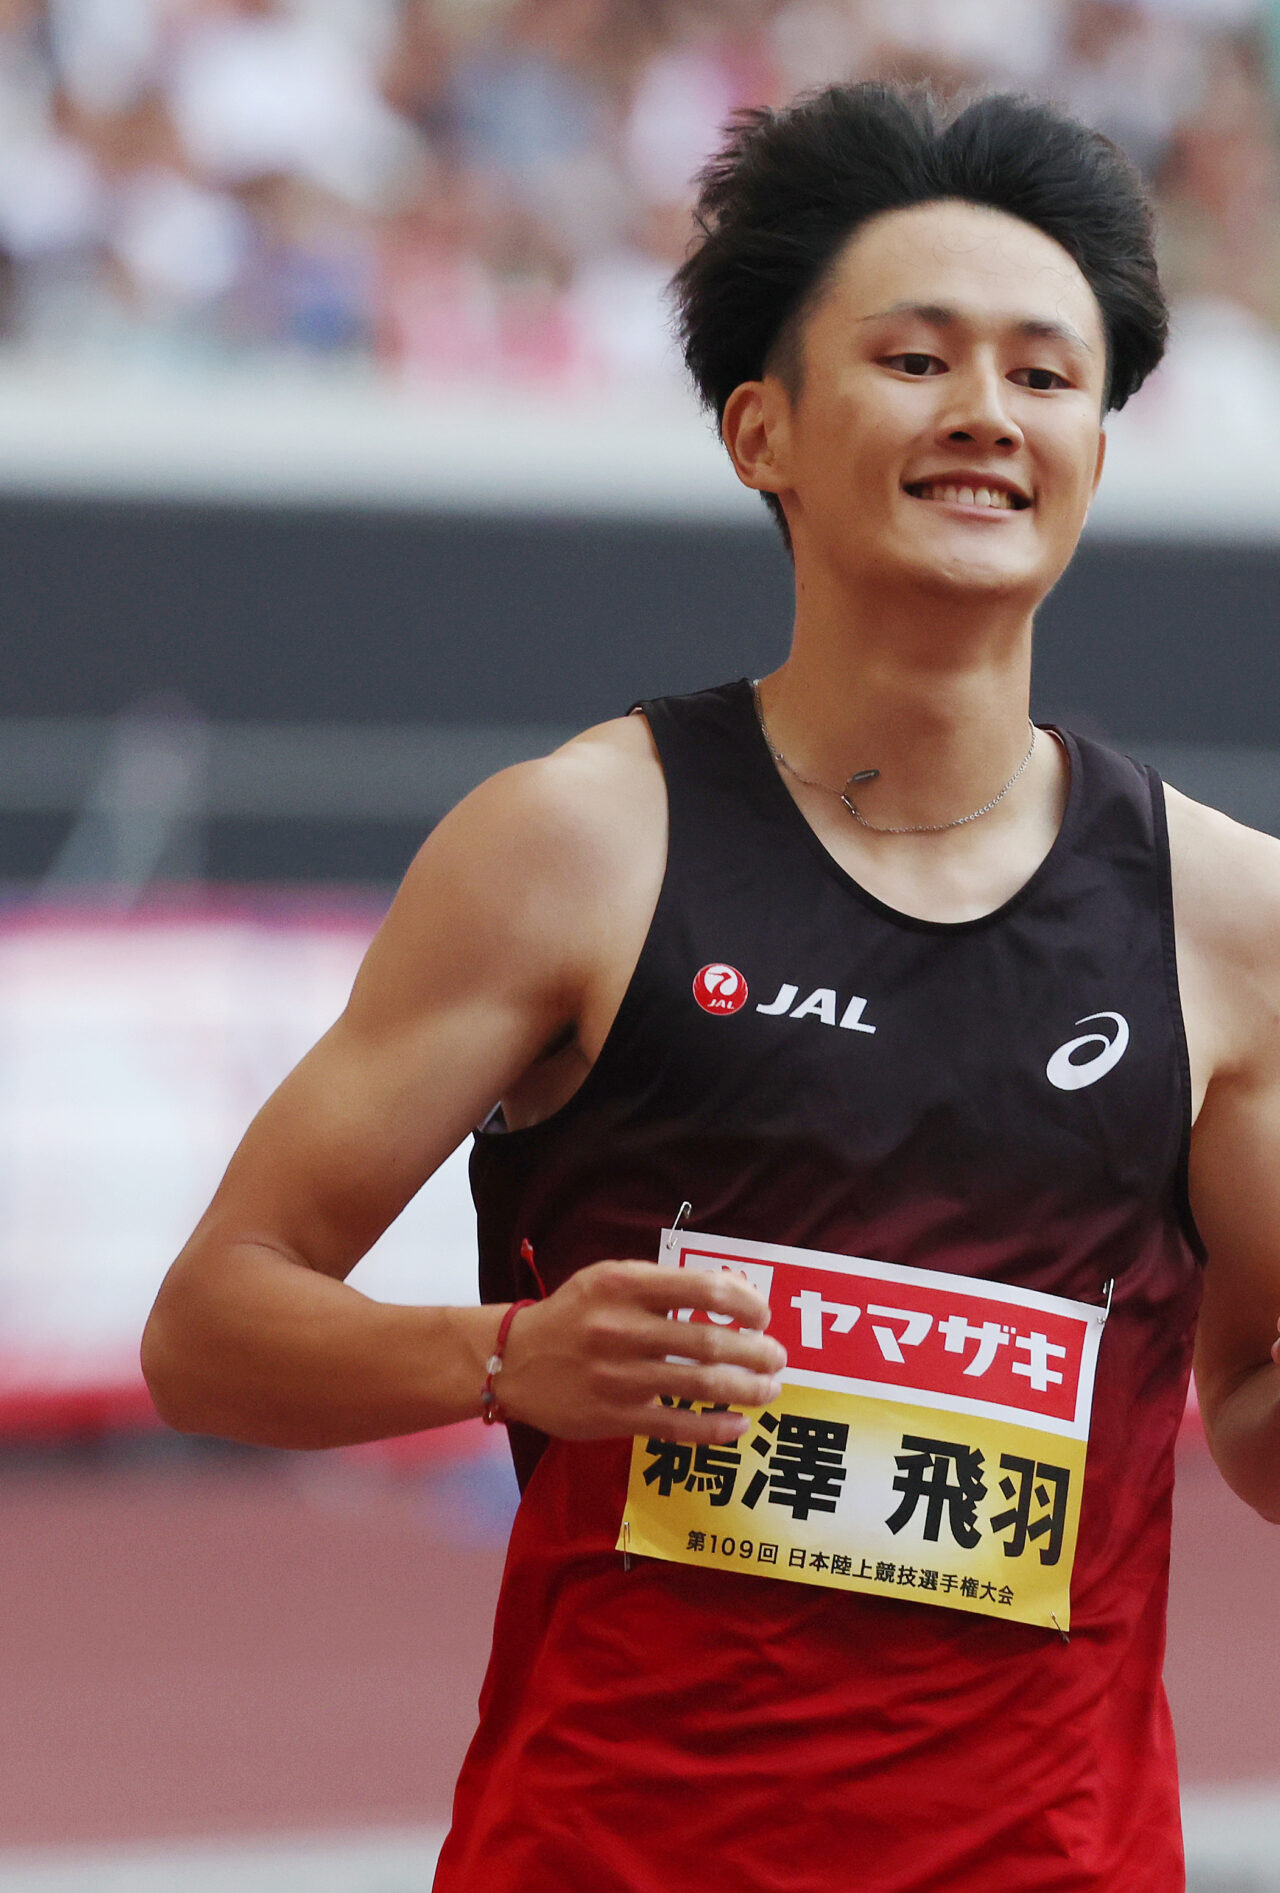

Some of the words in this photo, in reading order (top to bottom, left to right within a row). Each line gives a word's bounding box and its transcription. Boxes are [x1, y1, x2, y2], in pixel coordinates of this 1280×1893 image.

[707, 997, 735, 1010] JAL
[756, 983, 876, 1034] JAL
[790, 1289, 1067, 1393] ヤマザキ
[885, 1433, 1071, 1567] 飛羽
[686, 1529, 778, 1564] 第109回
[788, 1547, 1015, 1606] 日本陸上競技選手権大会
